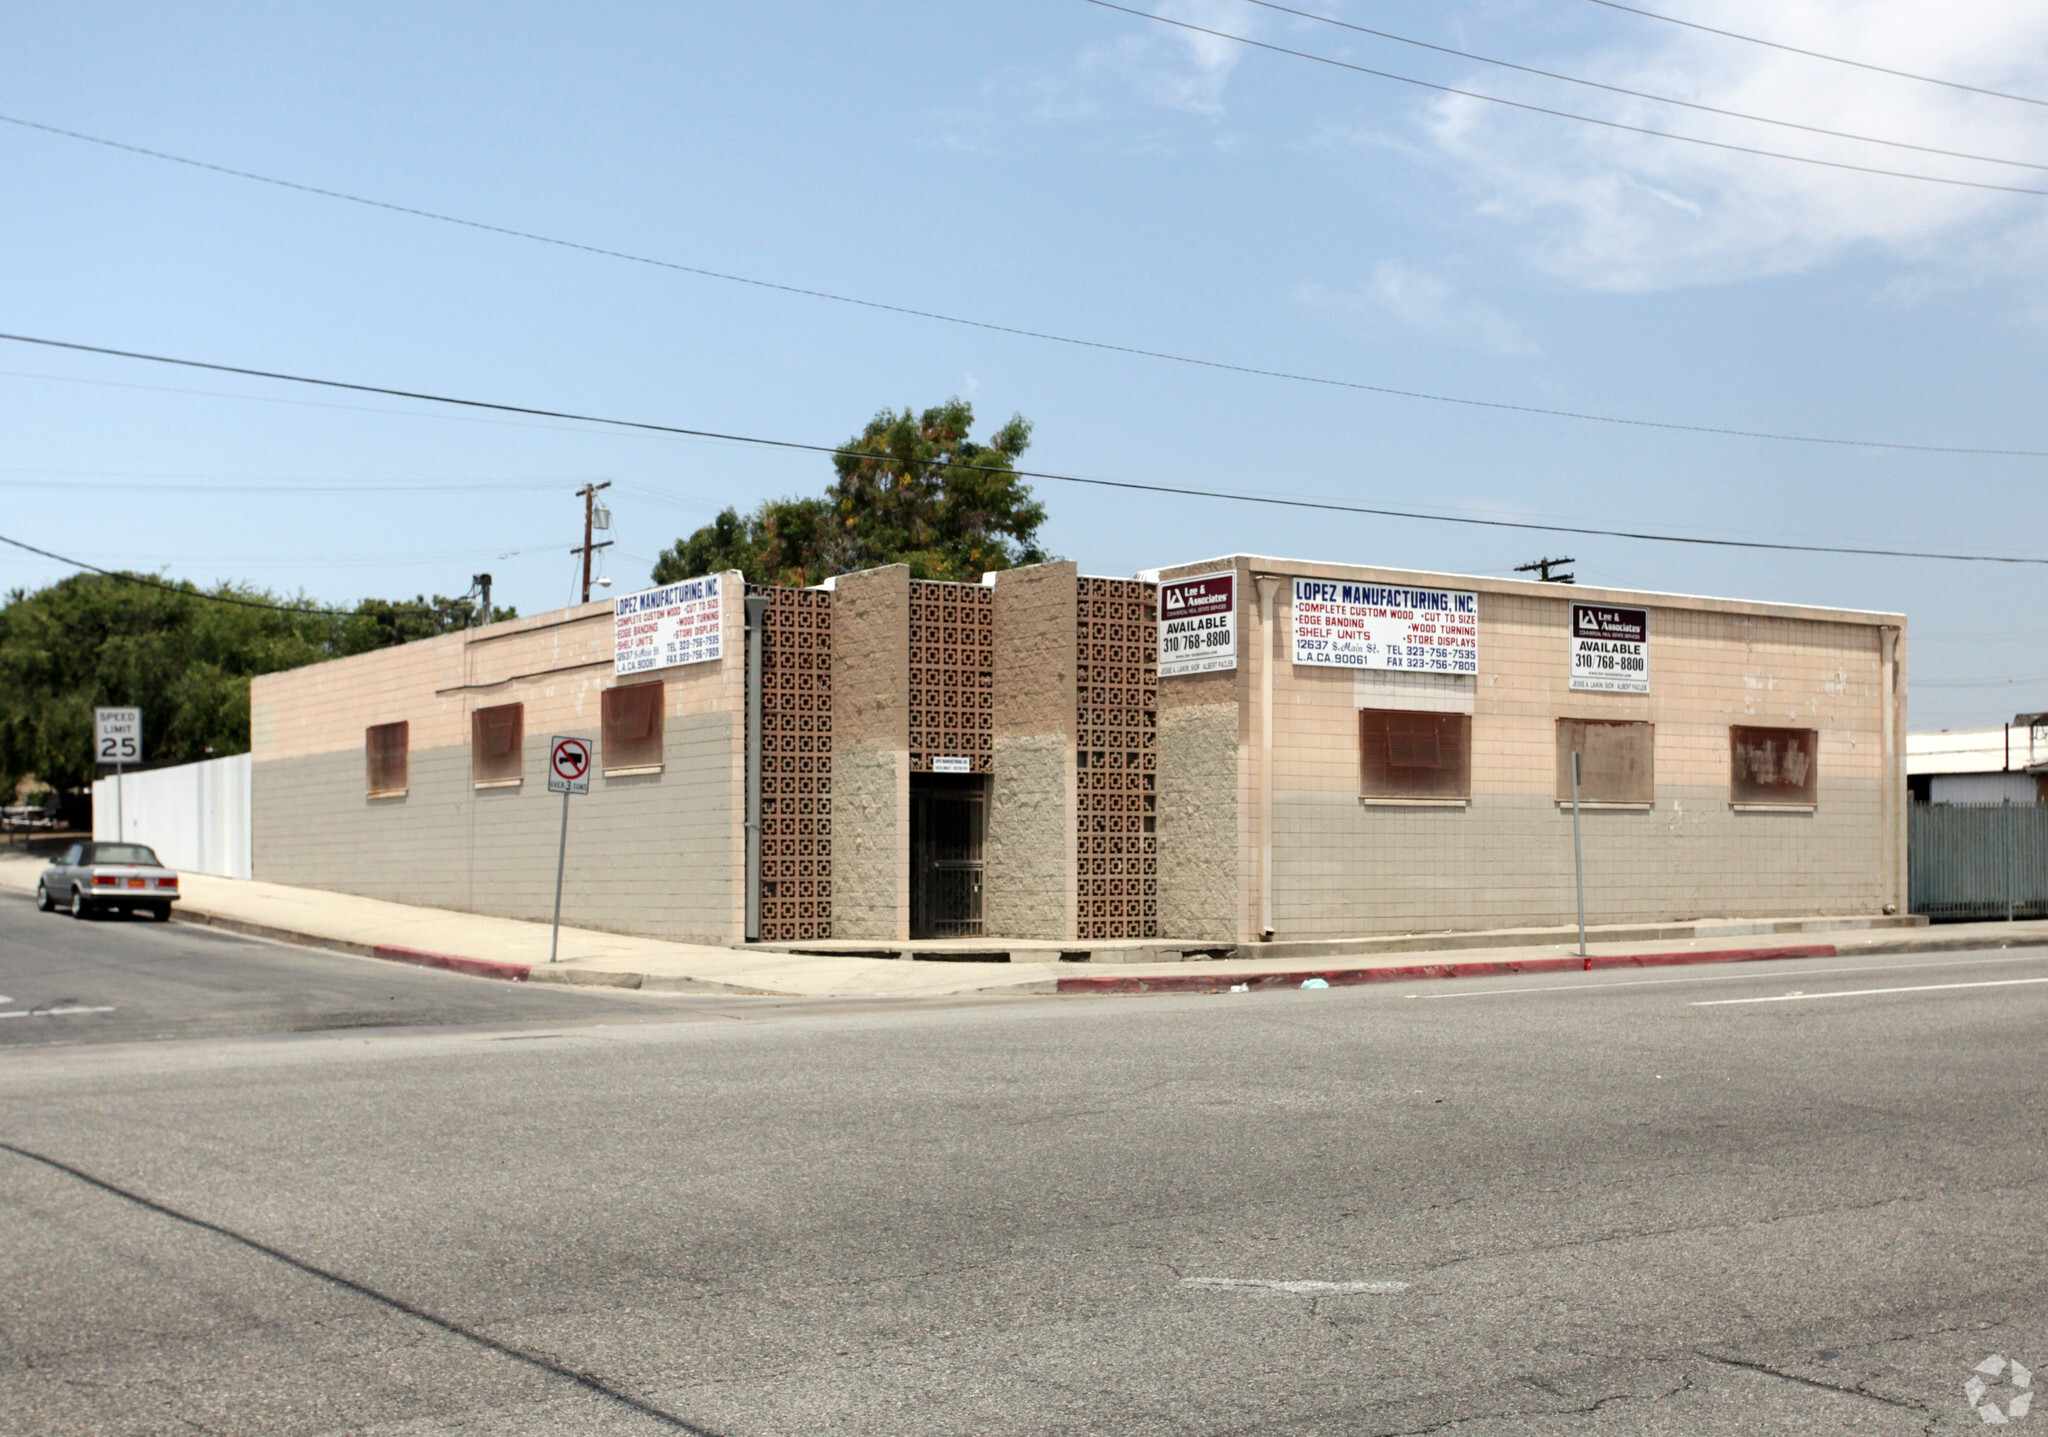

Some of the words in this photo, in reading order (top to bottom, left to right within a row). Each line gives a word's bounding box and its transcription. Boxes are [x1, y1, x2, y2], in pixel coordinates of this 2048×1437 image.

[616, 596, 637, 616] LOPEZ
[640, 582, 704, 611] MANUFACTURING,
[706, 578, 719, 598] INC.
[1185, 587, 1198, 596] Lee
[1200, 585, 1205, 594] &
[1296, 582, 1337, 602] LOPEZ
[1342, 585, 1452, 612] MANUFACTURING,
[1455, 595, 1476, 613] INC.
[686, 603, 696, 614] CUT
[699, 601, 705, 611] TO
[707, 599, 718, 609] SIZE
[1188, 593, 1227, 606] Associates
[617, 614, 641, 628] COMPLETE
[644, 610, 665, 621] CUSTOM
[667, 606, 680, 617] WOOD
[679, 616, 694, 626] WOOD
[697, 611, 719, 624] TURNING
[1299, 603, 1346, 615] COMPLETE
[1350, 606, 1387, 618] CUSTOM
[1390, 610, 1413, 620] WOOD
[1424, 612, 1440, 622] CUT
[1444, 614, 1455, 623] TO
[1459, 615, 1475, 624] SIZE
[1598, 612, 1612, 621] Lee
[1614, 613, 1619, 622] &
[1167, 616, 1226, 634] AVAILABLE
[1299, 615, 1321, 625] EDGE
[1326, 617, 1364, 628] BANDING
[1601, 622, 1640, 633] Associates
[617, 628, 632, 639] EDGE
[634, 623, 658, 636] BANDING
[675, 629, 693, 639] STORE
[695, 623, 719, 635] DISPLAYS
[1299, 627, 1332, 638] SHELF
[1338, 630, 1370, 640] UNITS
[1412, 623, 1436, 633] WOOD
[1441, 625, 1475, 636] TURNING
[617, 639, 634, 650] SHELF
[636, 636, 653, 647] UNITS
[667, 643, 676, 652] TEL
[679, 635, 719, 650] 323-756-7535
[1164, 630, 1230, 652] 310/768-8800
[1297, 640, 1328, 650] 12637
[1407, 635, 1434, 645] STORE
[1438, 637, 1475, 648] DISPLAYS
[1580, 641, 1640, 655] AVAILABLE
[616, 650, 632, 661] 12637
[1387, 645, 1402, 655] TEL
[1407, 647, 1475, 659] 323-756-7535
[667, 655, 677, 664] FAX
[1387, 657, 1402, 667] FAX
[1407, 658, 1475, 671] 323-756-7809
[1576, 654, 1644, 671] 310/768-8800
[100, 713, 135, 721] SPEED
[104, 725, 131, 733] LIMIT
[102, 738, 136, 757] 25
[566, 780, 571, 791] 3
